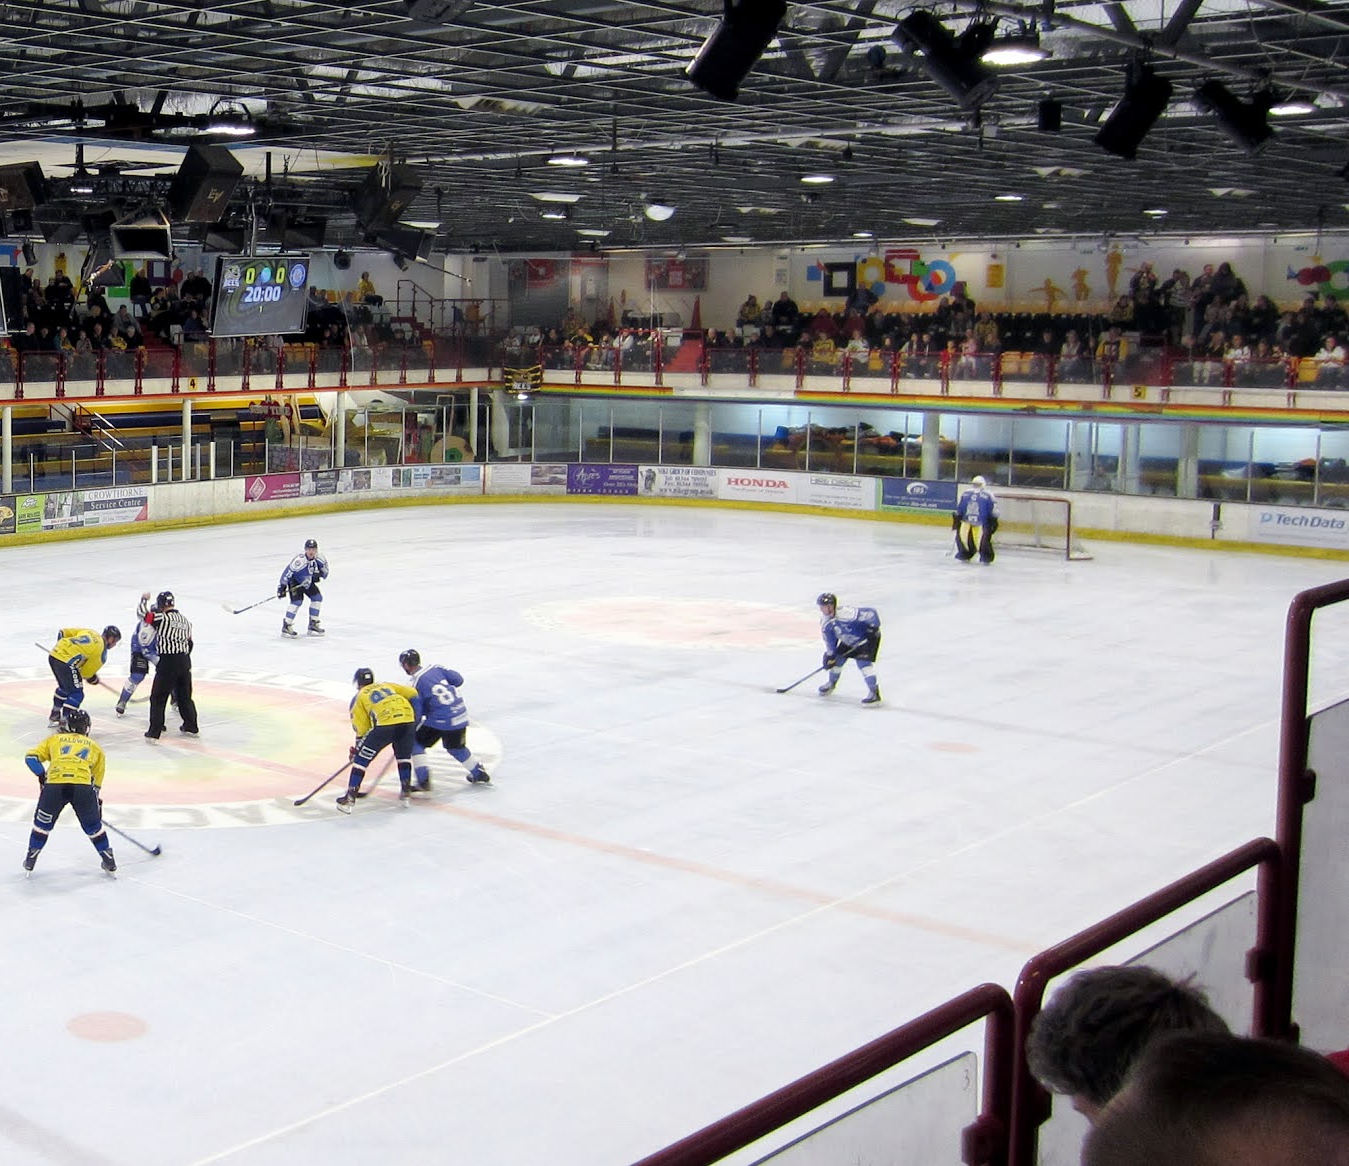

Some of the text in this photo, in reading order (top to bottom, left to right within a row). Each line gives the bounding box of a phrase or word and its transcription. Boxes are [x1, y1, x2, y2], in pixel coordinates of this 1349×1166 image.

[245, 266, 285, 285] 0 0
[244, 286, 281, 303] 20:00
[190, 378, 196, 389] 4
[1134, 386, 1142, 397] 5
[726, 477, 790, 488] HONDA
[88, 487, 144, 500] CROWTHORNE
[90, 498, 141, 510] Service Centre
[1275, 513, 1346, 529] Tech Data
[59, 737, 92, 746] BALDWIN
[59, 744, 91, 761] 14
